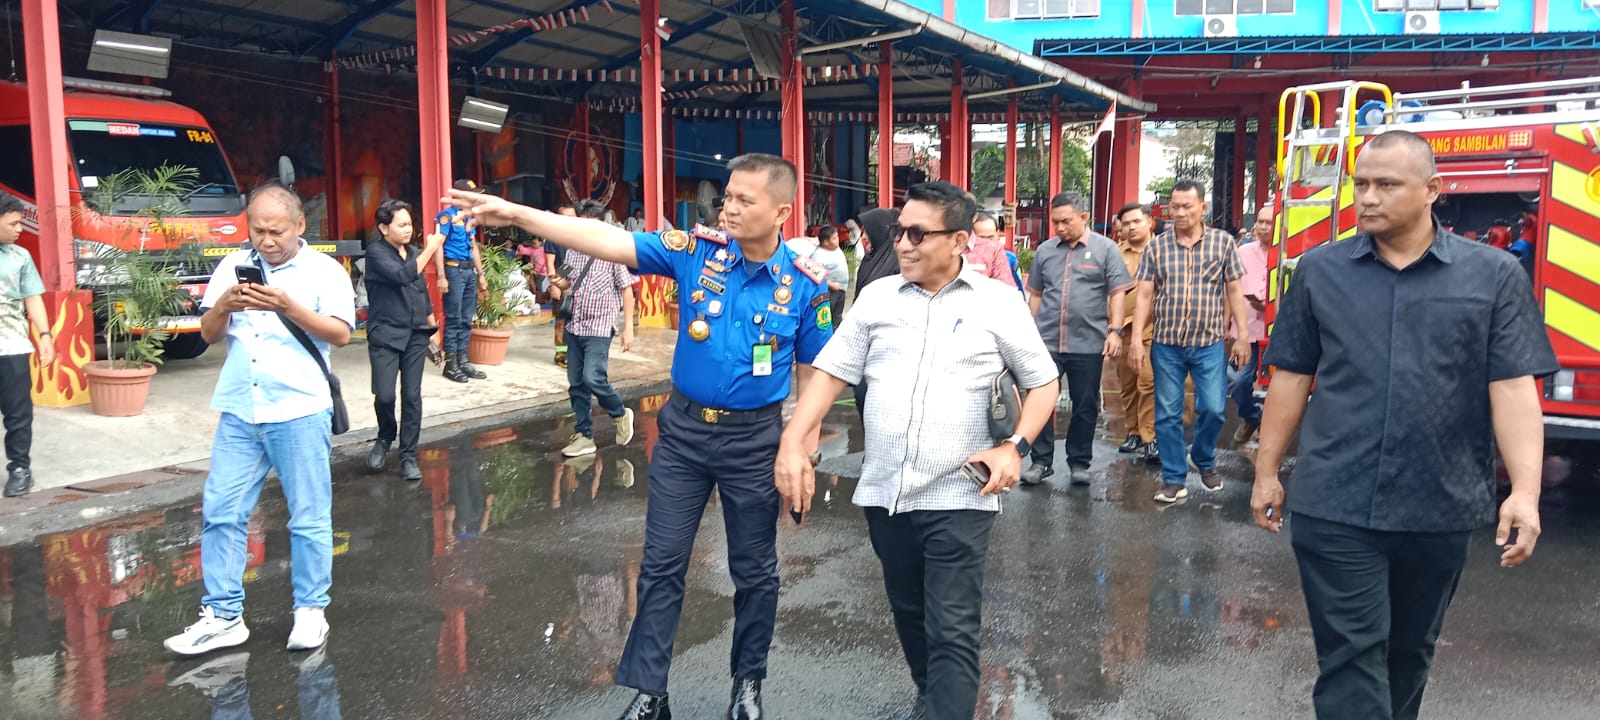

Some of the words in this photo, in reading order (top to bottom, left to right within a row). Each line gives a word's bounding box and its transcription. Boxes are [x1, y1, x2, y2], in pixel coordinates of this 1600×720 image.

[108, 125, 140, 135] MEDAN
[1428, 137, 1451, 153] ANG
[1453, 134, 1507, 152] SAMBILAN
